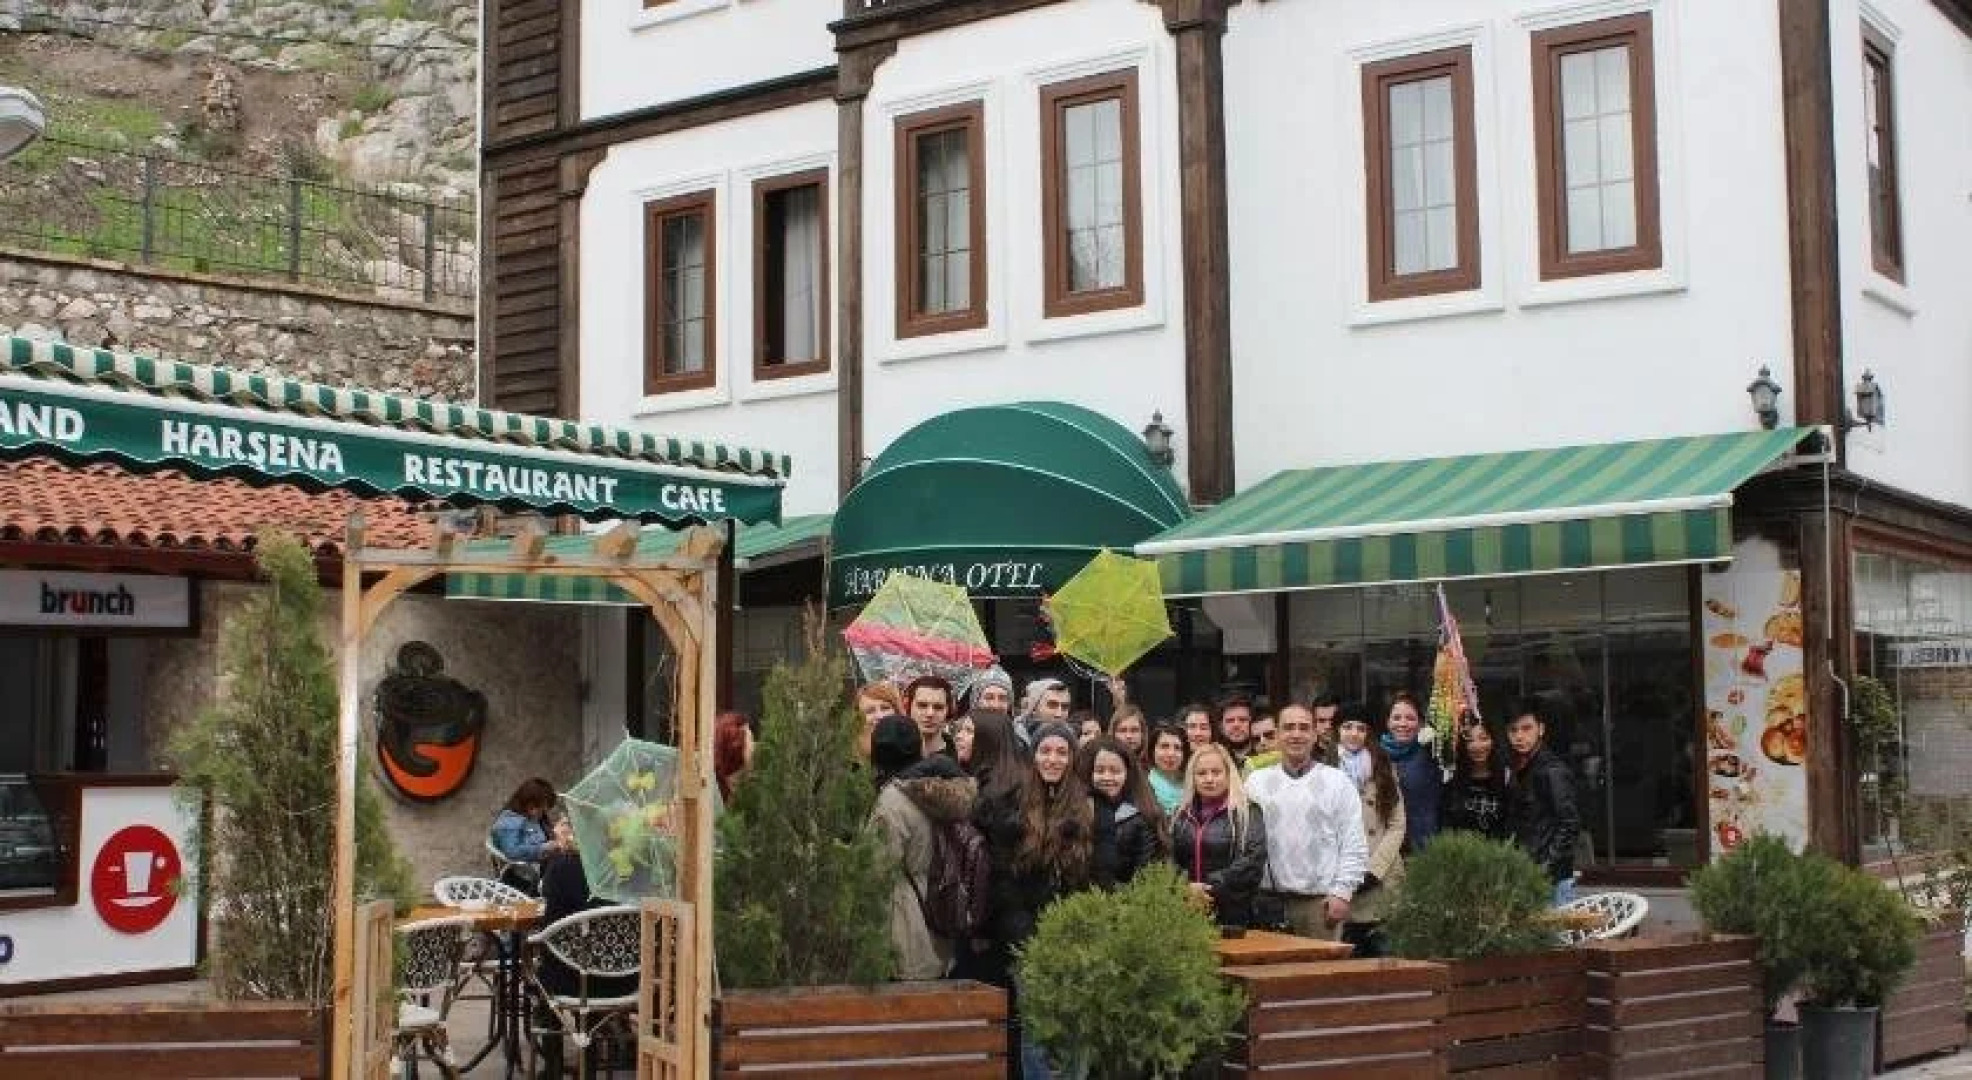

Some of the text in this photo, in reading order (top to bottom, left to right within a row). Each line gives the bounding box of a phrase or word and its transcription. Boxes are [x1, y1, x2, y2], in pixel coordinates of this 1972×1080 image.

[403, 452, 618, 503] RESTAURANT
[661, 484, 726, 513] CAFE
[966, 561, 1043, 588] OTEL
[41, 581, 135, 615] brunch
